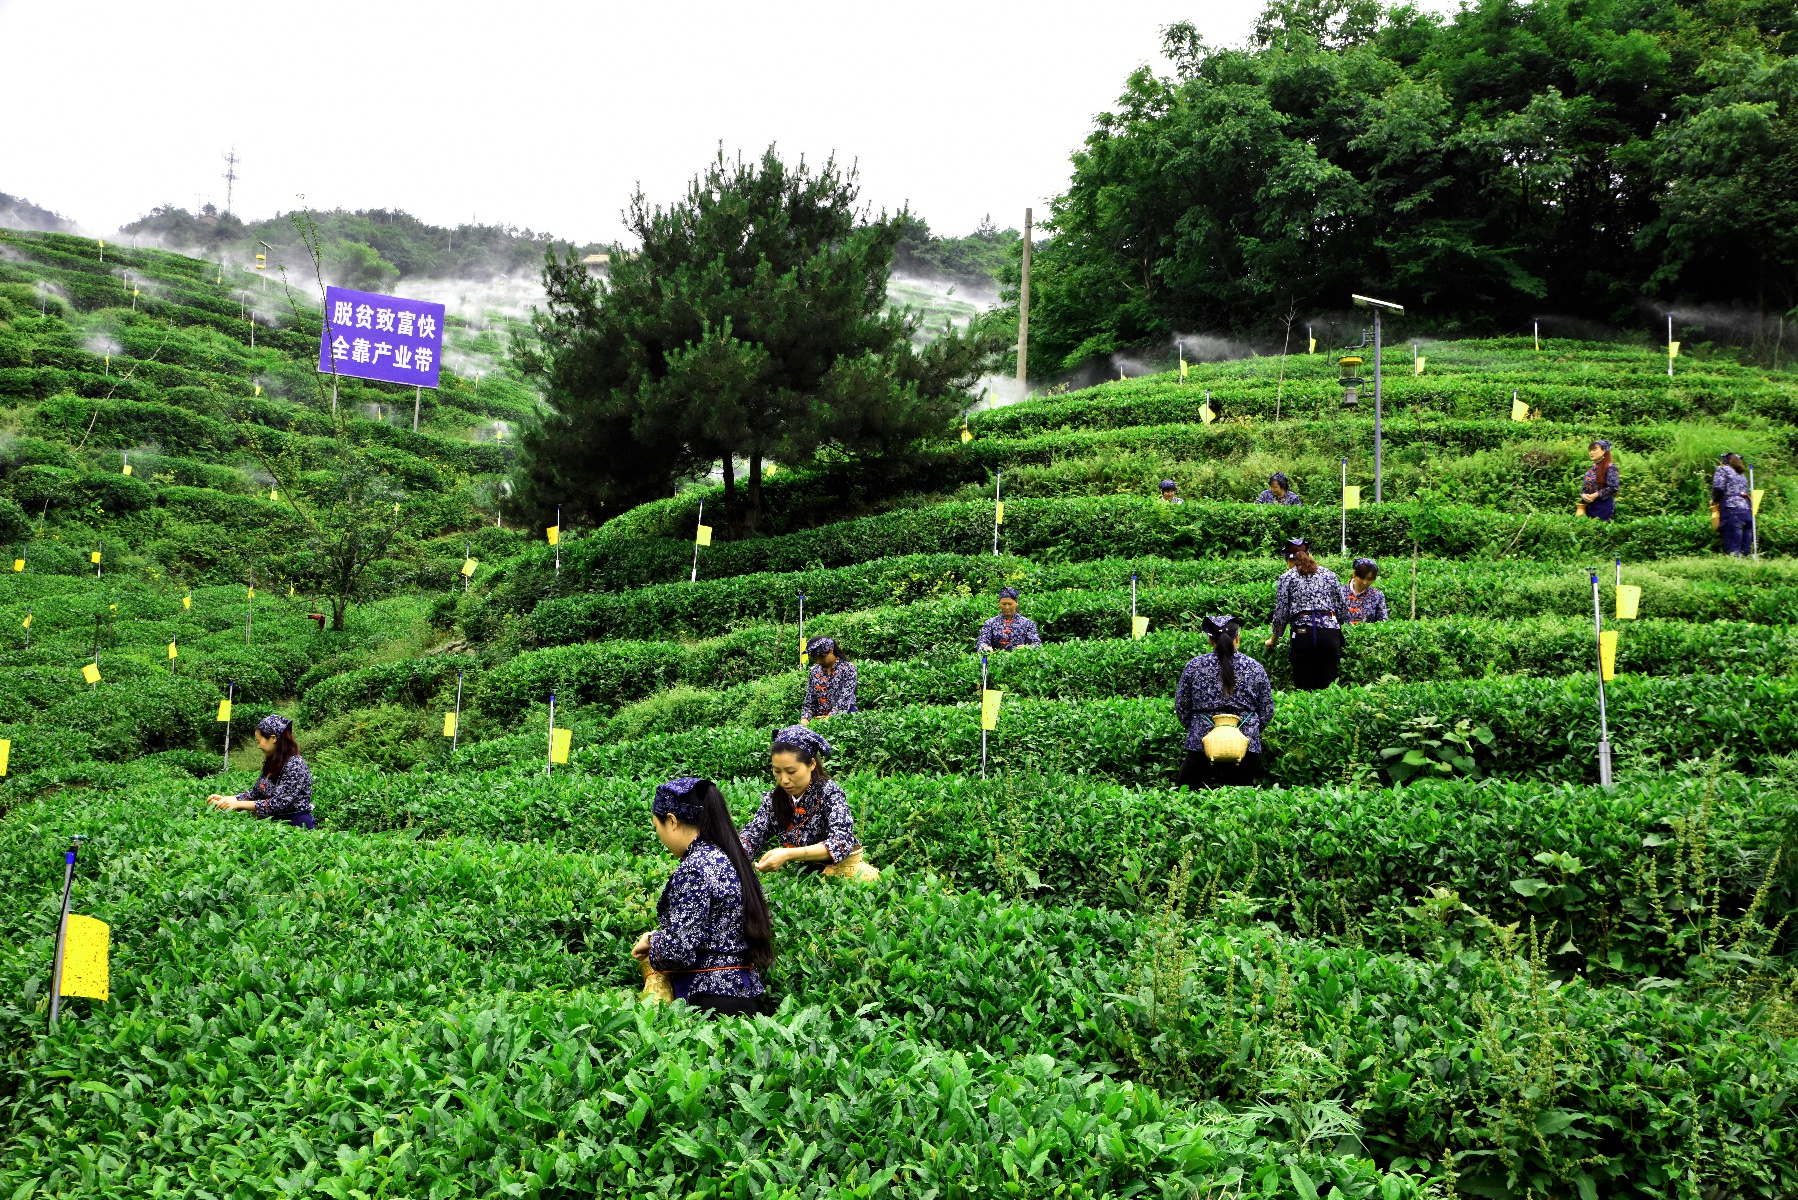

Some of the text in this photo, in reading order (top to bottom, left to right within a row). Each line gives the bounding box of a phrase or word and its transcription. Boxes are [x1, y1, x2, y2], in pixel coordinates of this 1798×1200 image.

[333, 301, 436, 339] 脱贫致富快
[331, 335, 433, 372] 全靠产业带
